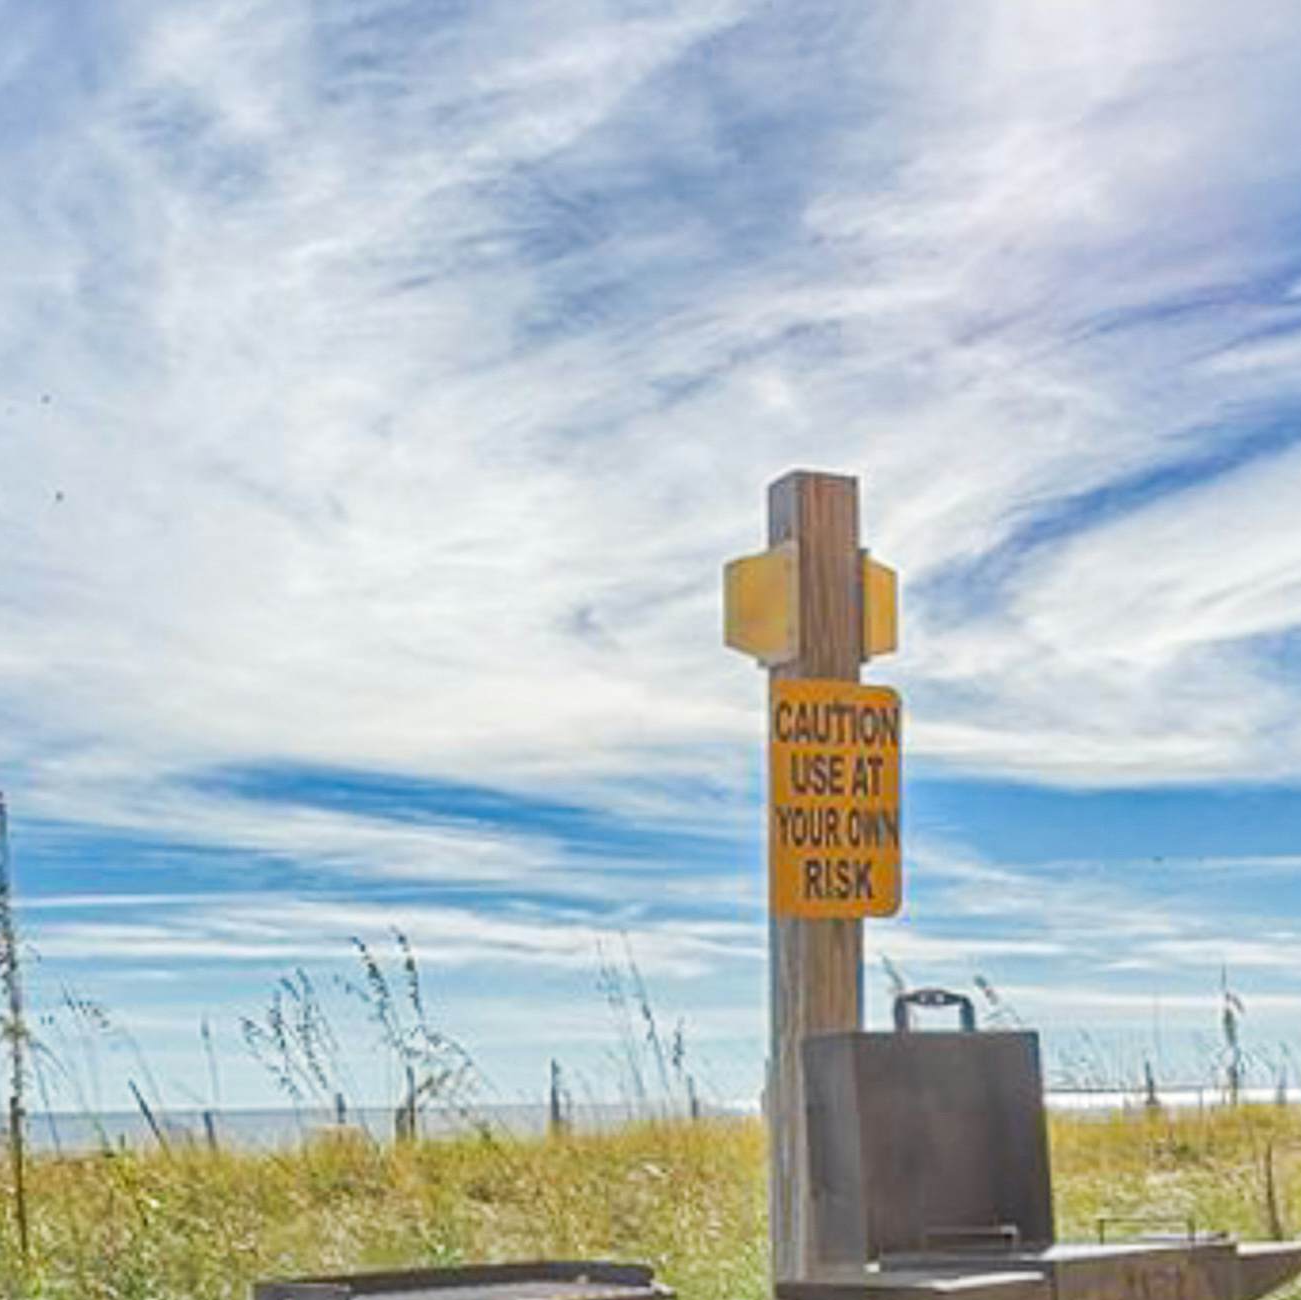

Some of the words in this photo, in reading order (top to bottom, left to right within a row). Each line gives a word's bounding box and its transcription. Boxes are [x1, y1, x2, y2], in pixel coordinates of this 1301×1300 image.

[775, 701, 899, 747] CAUTION
[790, 754, 845, 795] USE
[851, 757, 884, 797] AT
[776, 806, 839, 847] YOUR
[846, 807, 899, 848] OWN
[804, 859, 874, 899] RISK
